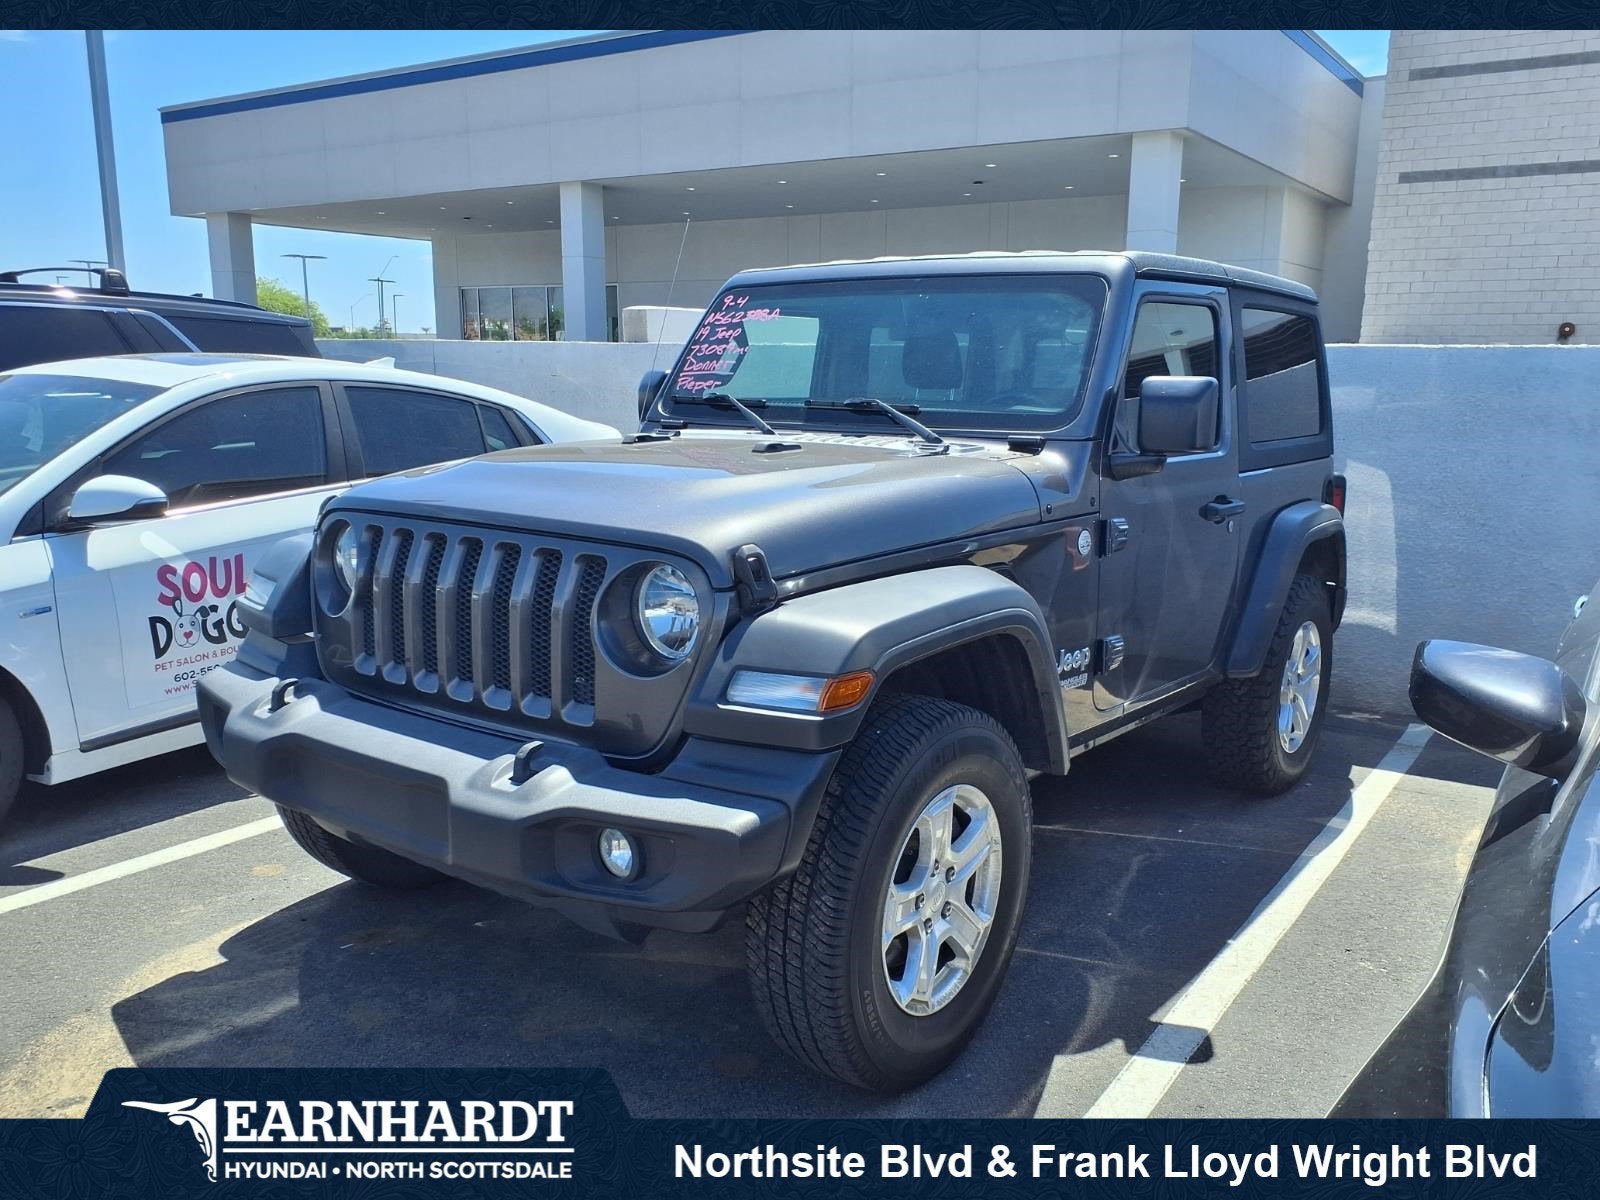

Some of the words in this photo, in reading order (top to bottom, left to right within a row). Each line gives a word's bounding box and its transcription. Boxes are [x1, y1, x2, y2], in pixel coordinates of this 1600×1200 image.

[722, 295, 749, 310] 9-4
[696, 326, 710, 342] 19
[709, 327, 742, 342] Jeep
[157, 553, 247, 607] SOUL
[155, 660, 174, 672] PET
[176, 652, 210, 667] SALON
[212, 650, 218, 658] &
[1056, 647, 1091, 674] Jeep
